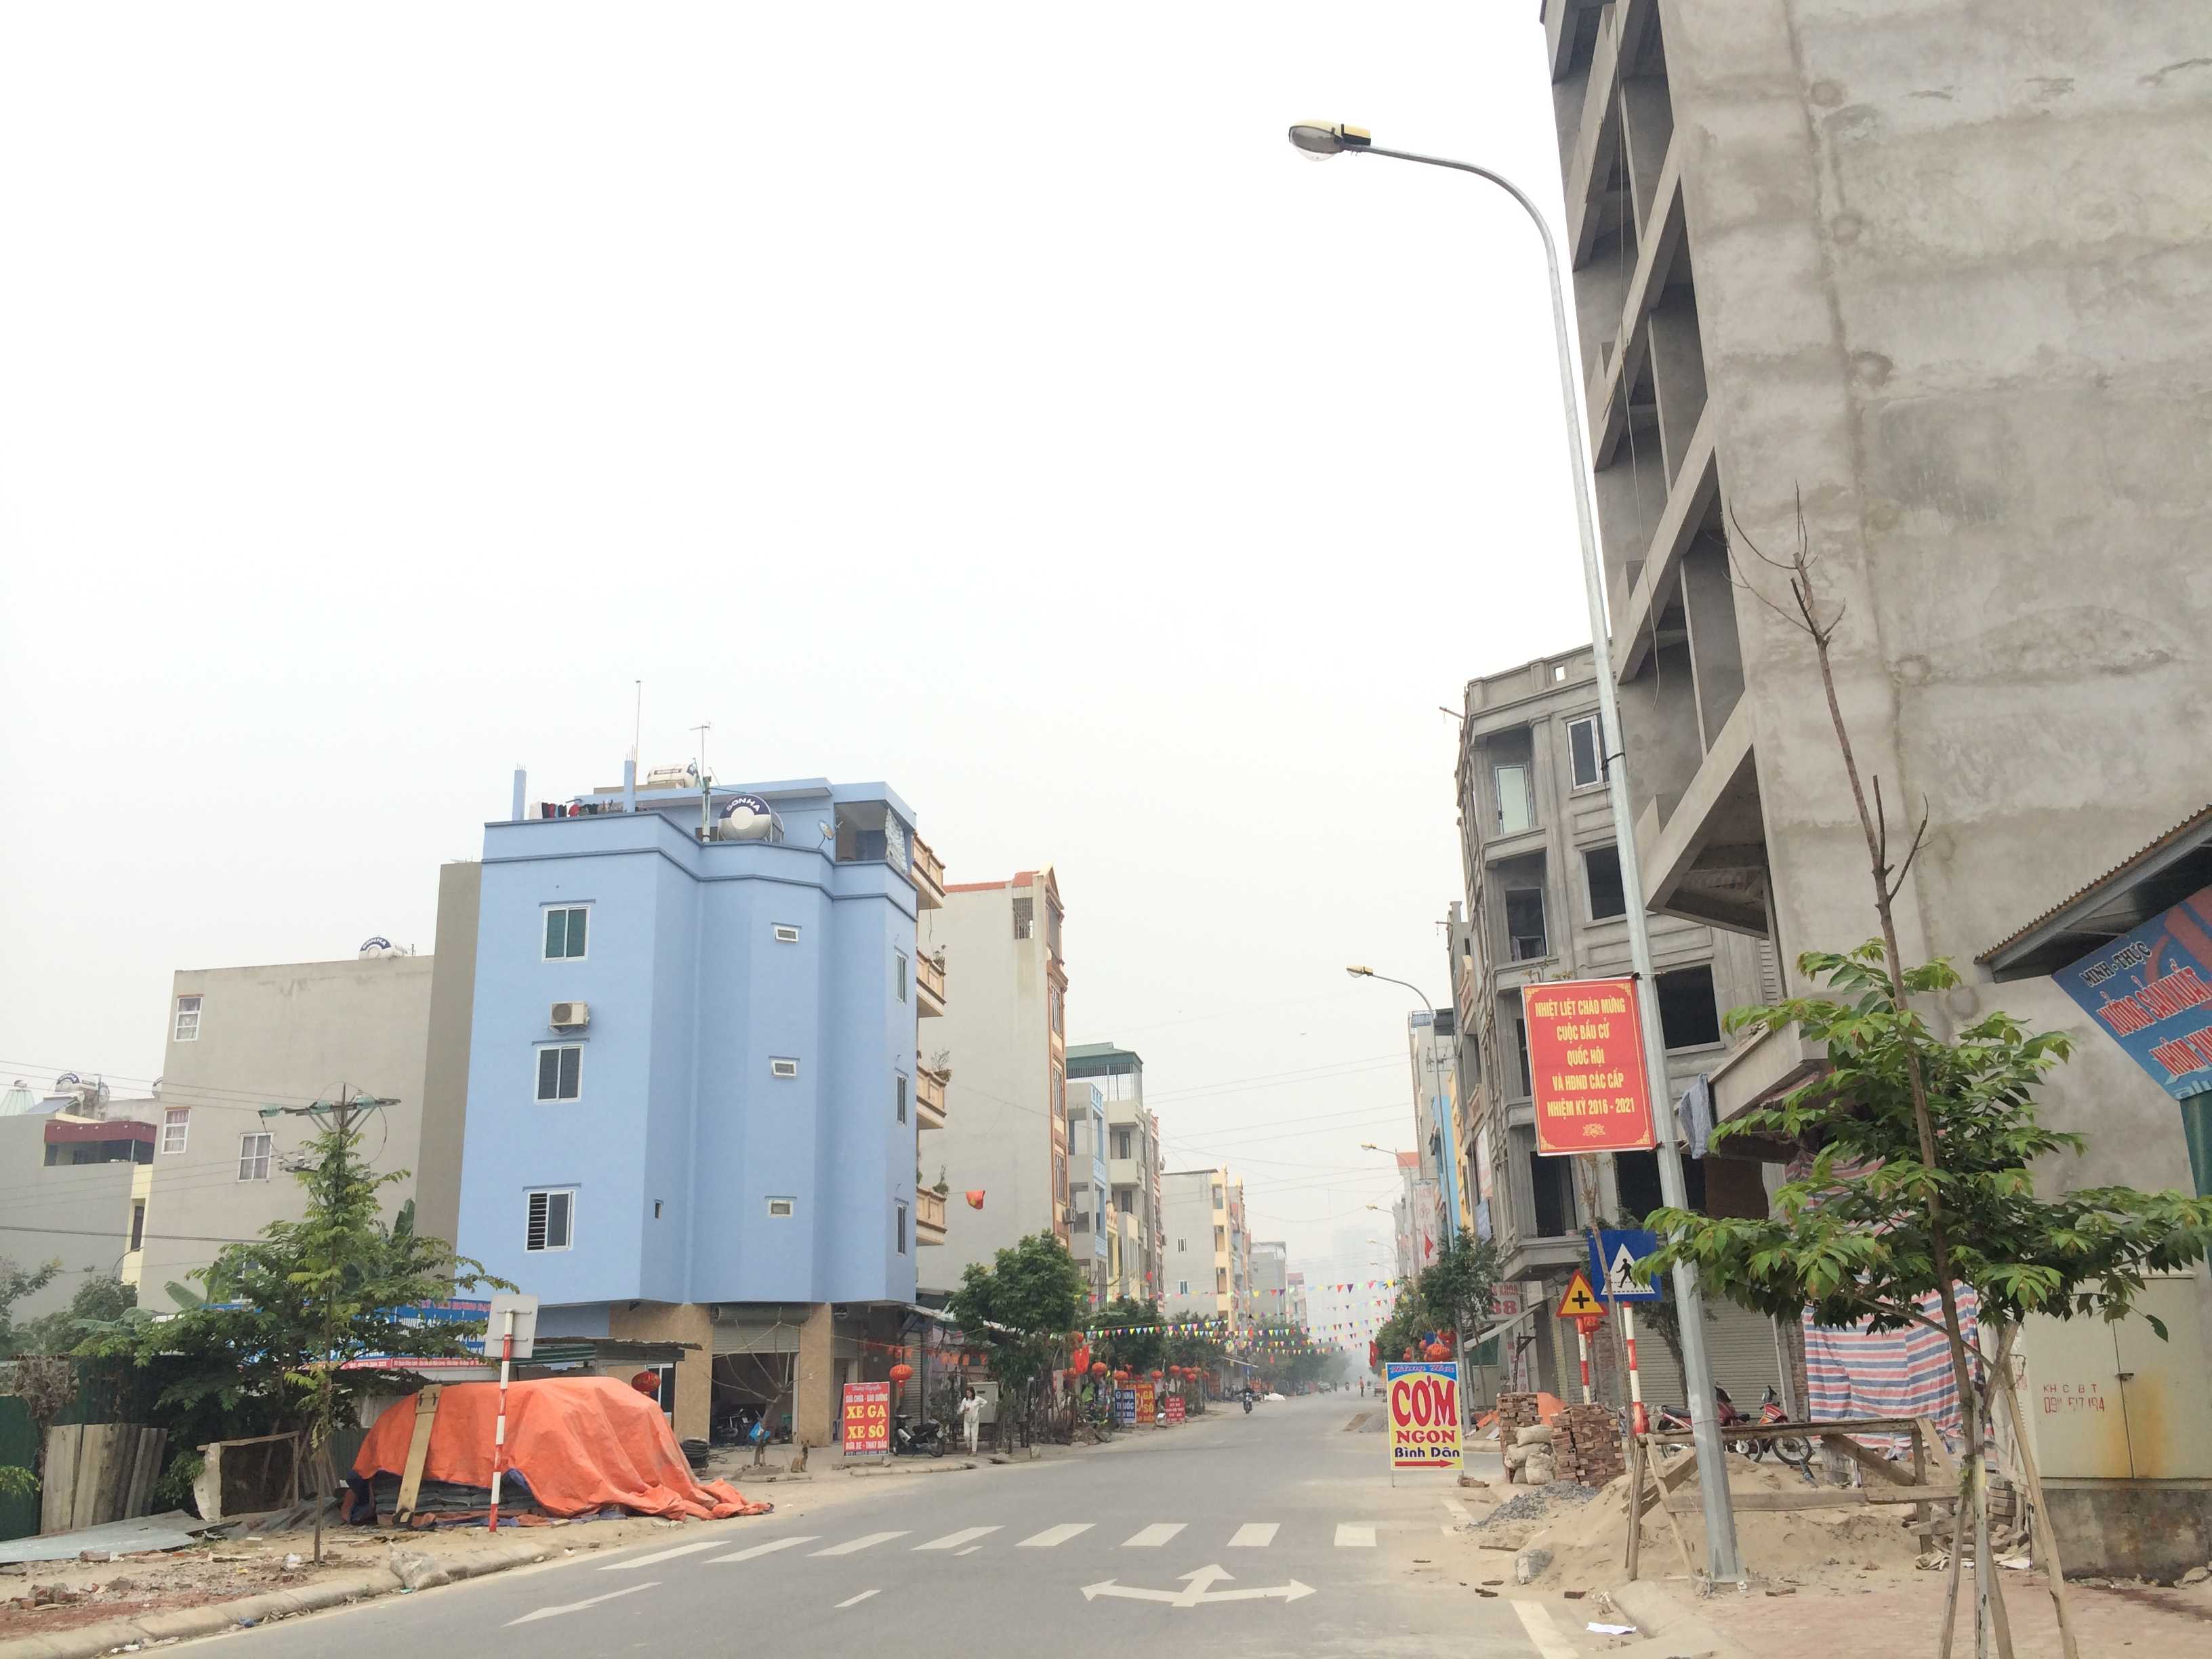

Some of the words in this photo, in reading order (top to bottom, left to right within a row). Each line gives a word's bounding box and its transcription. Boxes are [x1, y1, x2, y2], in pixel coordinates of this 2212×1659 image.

[2078, 961, 2116, 987] MINH
[2111, 941, 2152, 970] THỰC
[1534, 998, 1558, 1019] NHIỆT
[1559, 997, 1576, 1019] LIỆT
[1577, 996, 1600, 1015] CHÀO
[1600, 994, 1626, 1014] MỪNG
[2095, 991, 2156, 1037] XƯỞNG
[1556, 1021, 1578, 1044] CUỘC
[1597, 1017, 1610, 1039] CỬ
[1566, 1044, 1589, 1067] QUỐC
[1590, 1045, 1605, 1067] HỘI
[2148, 1036, 2208, 1078] NHÔM
[1552, 1072, 1564, 1091] VÀ
[1589, 1070, 1605, 1089] CÁC
[1607, 1067, 1624, 1088] CẤP
[1547, 1097, 1574, 1120] NHIỆM
[1575, 1097, 1586, 1115] KỲ
[1588, 1099, 1608, 1115] 2016
[1615, 1097, 1635, 1113] 2021
[846, 1406, 865, 1419] XE
[867, 1404, 887, 1418] GA
[1391, 1374, 1458, 1427] CƠM
[847, 1425, 865, 1439] XE
[868, 1418, 886, 1438] SỐ
[1395, 1430, 1456, 1443] NGON
[1394, 1446, 1426, 1458] Bình
[1431, 1446, 1460, 1458] Dân
